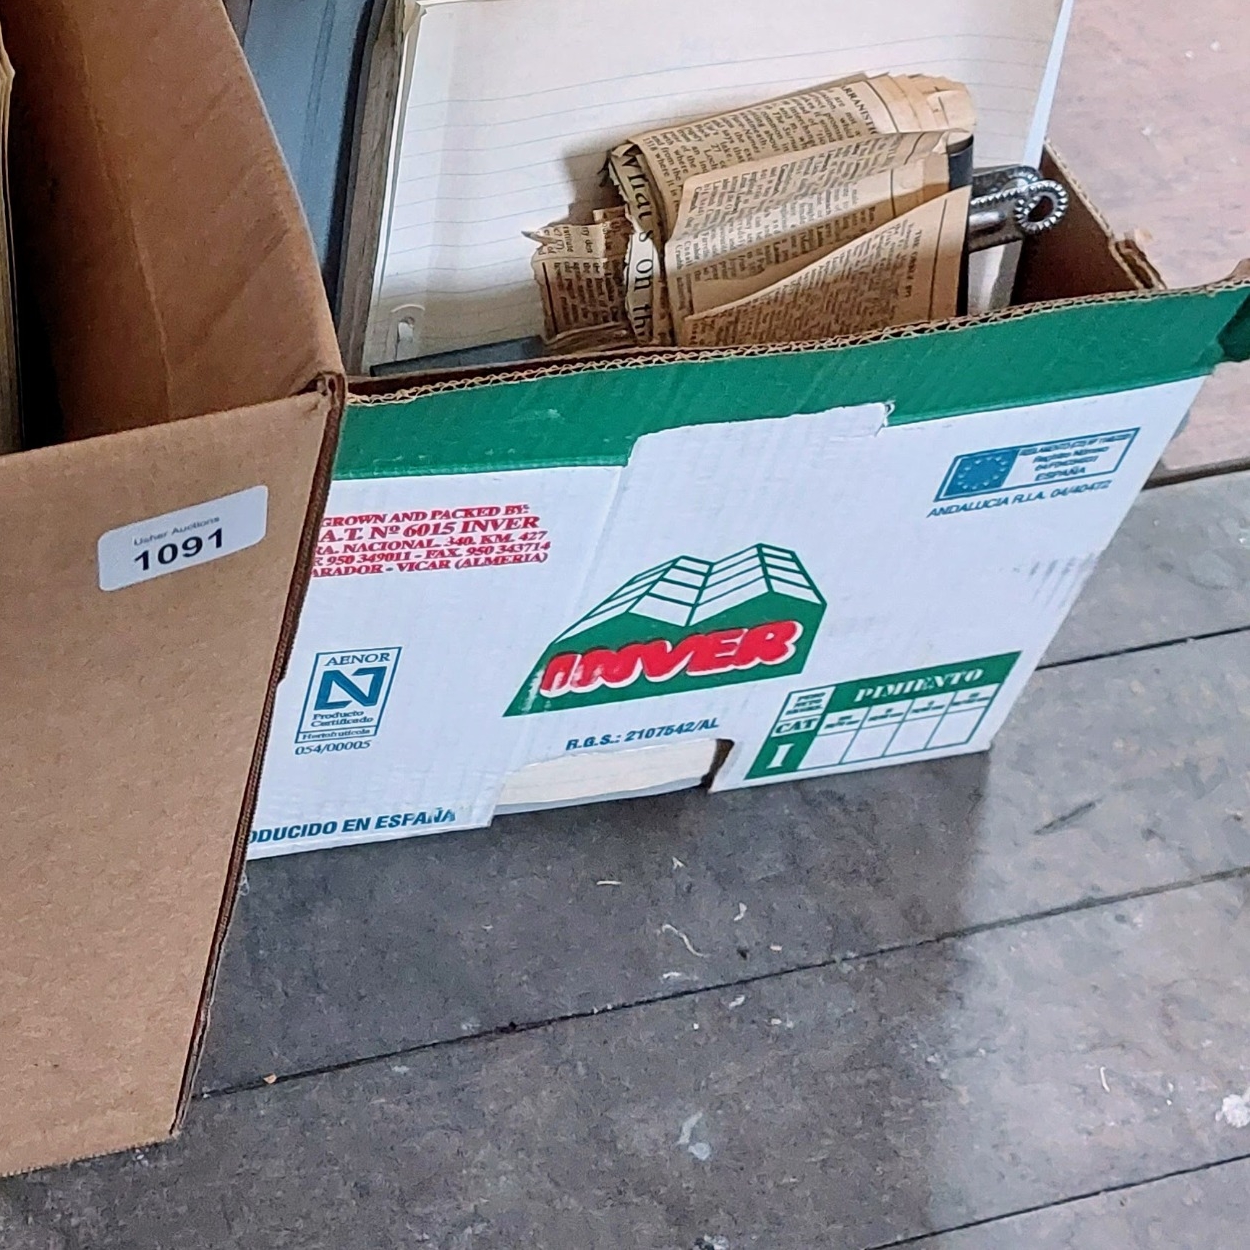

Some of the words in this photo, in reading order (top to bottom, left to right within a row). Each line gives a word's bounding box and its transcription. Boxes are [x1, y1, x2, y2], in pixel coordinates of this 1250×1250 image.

[655, 153, 670, 177] where
[321, 512, 386, 527] GROWN
[388, 510, 427, 523] AND
[430, 506, 501, 521] PACKED
[402, 522, 457, 537] 6015
[459, 516, 540, 534] INVER
[134, 531, 168, 547] Usher
[171, 516, 220, 535] Auctions
[518, 530, 548, 541] 427
[134, 527, 223, 571] 1091
[327, 554, 356, 566] 950
[356, 551, 411, 564] 349011
[465, 545, 493, 557] 950
[495, 541, 551, 555] 343714
[399, 559, 452, 573] VICAR
[454, 552, 549, 570] (ALMERIA)
[324, 652, 391, 666] AENOR
[539, 620, 804, 698] INVER
[854, 668, 984, 702] PIMIENTO
[311, 716, 374, 727] Certificado
[312, 710, 364, 720] Producto
[775, 717, 819, 735] CAT
[295, 739, 372, 755] 054/00005
[341, 817, 371, 833] EN
